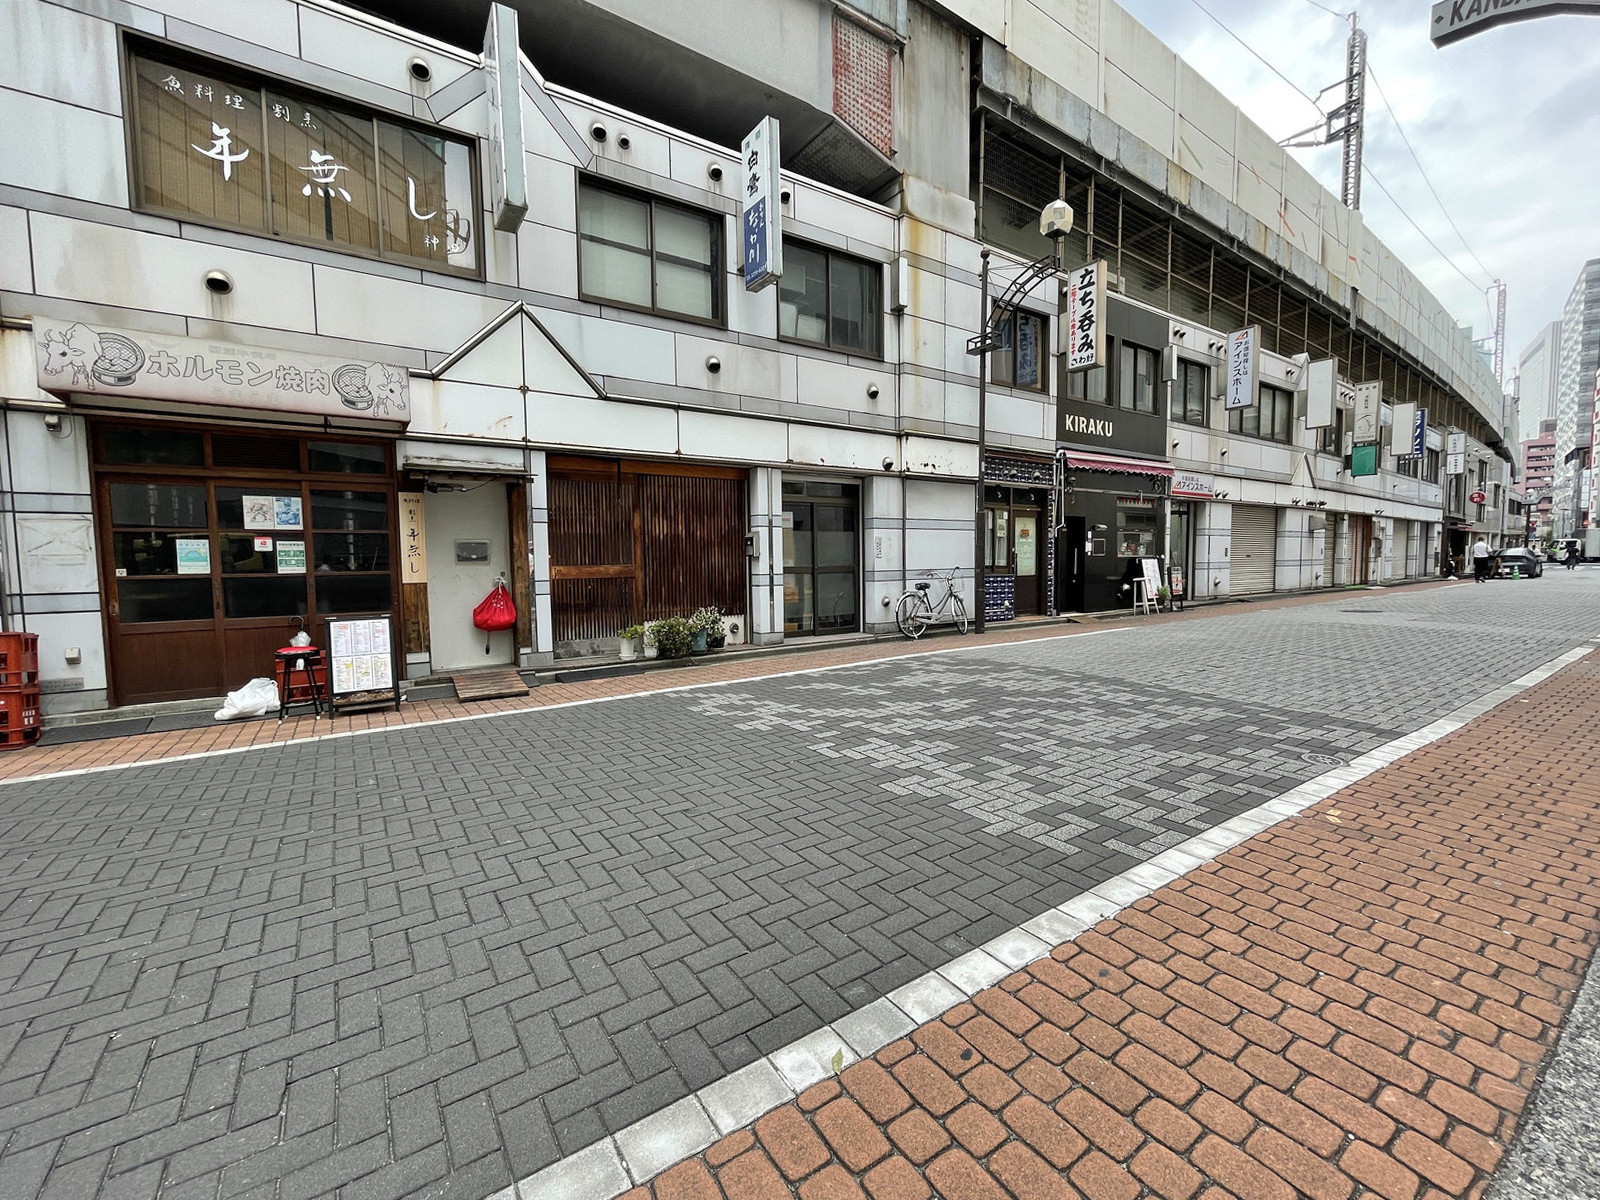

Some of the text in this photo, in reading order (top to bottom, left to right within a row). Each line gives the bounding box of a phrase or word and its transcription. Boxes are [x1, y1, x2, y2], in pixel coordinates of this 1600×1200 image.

[161, 74, 246, 110] 魚料理
[190, 121, 438, 221] 年無し
[1077, 268, 1096, 354] 立ち呑み
[147, 350, 332, 396] ホルモン焼肉
[1232, 341, 1242, 405] アインスホーム
[1065, 413, 1113, 438] KIRAKU
